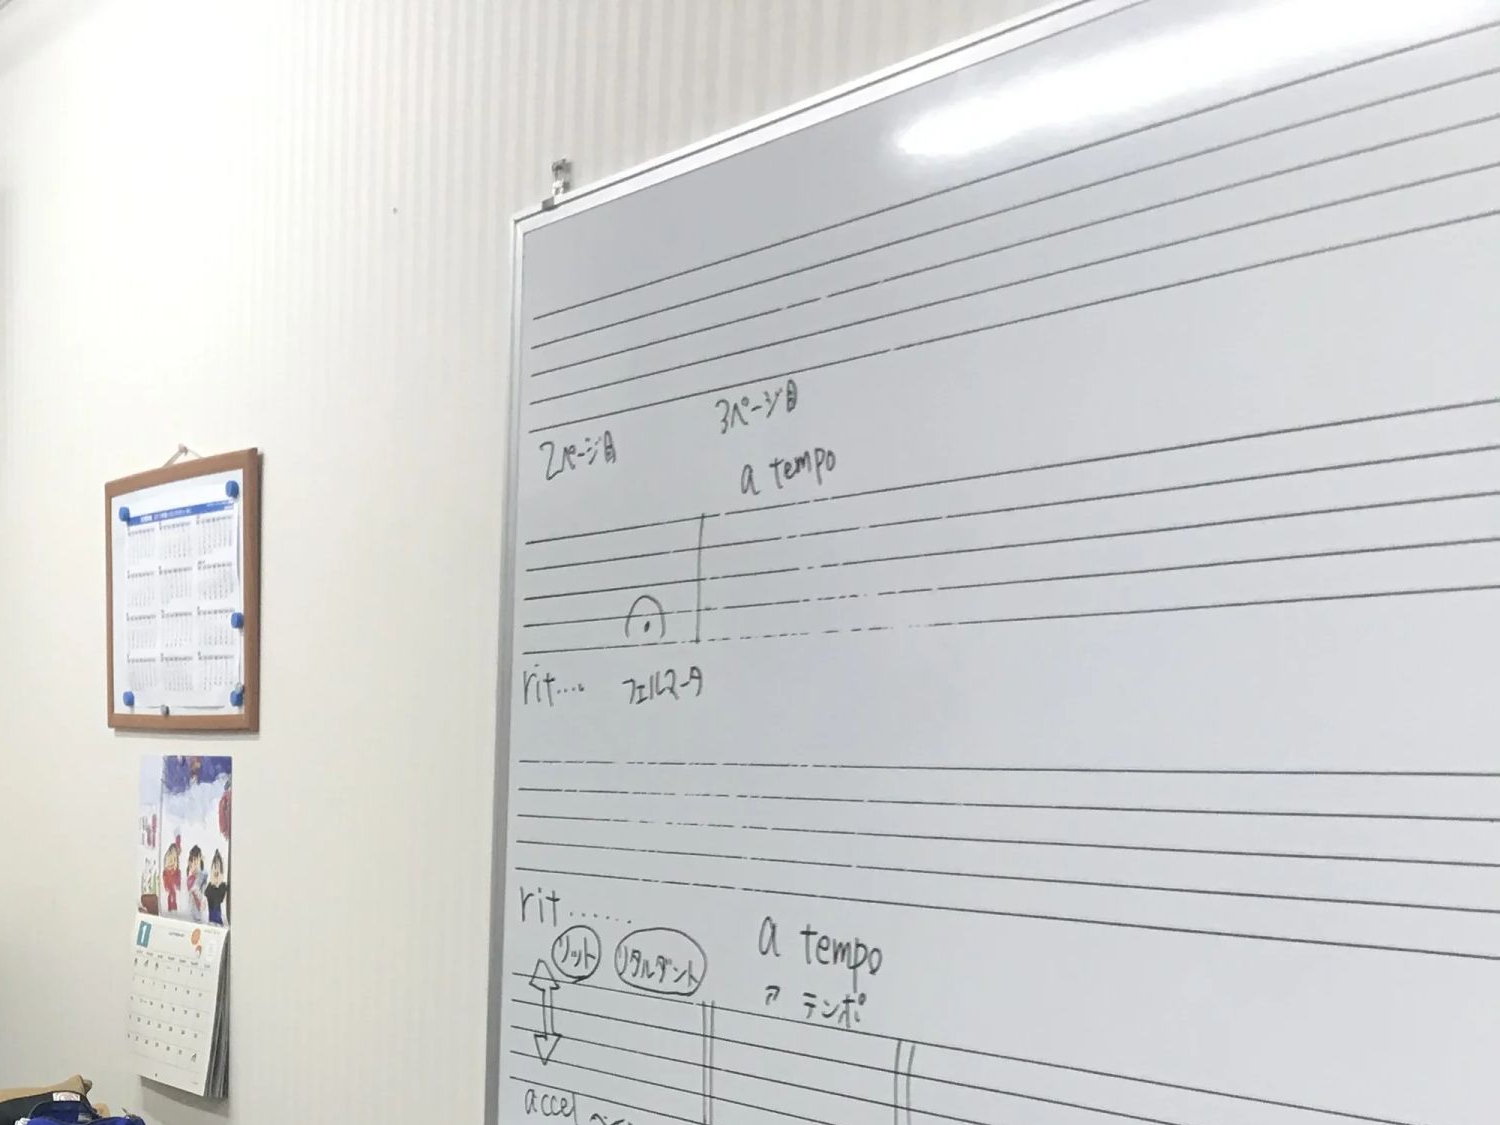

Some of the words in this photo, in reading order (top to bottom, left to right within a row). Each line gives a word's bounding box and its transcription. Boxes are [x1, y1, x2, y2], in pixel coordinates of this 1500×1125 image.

[740, 464, 761, 495] a
[769, 447, 837, 490] tempo
[557, 934, 596, 970] リット
[759, 915, 781, 957] a
[799, 923, 883, 994] tempo
[802, 991, 867, 1029] テンポ
